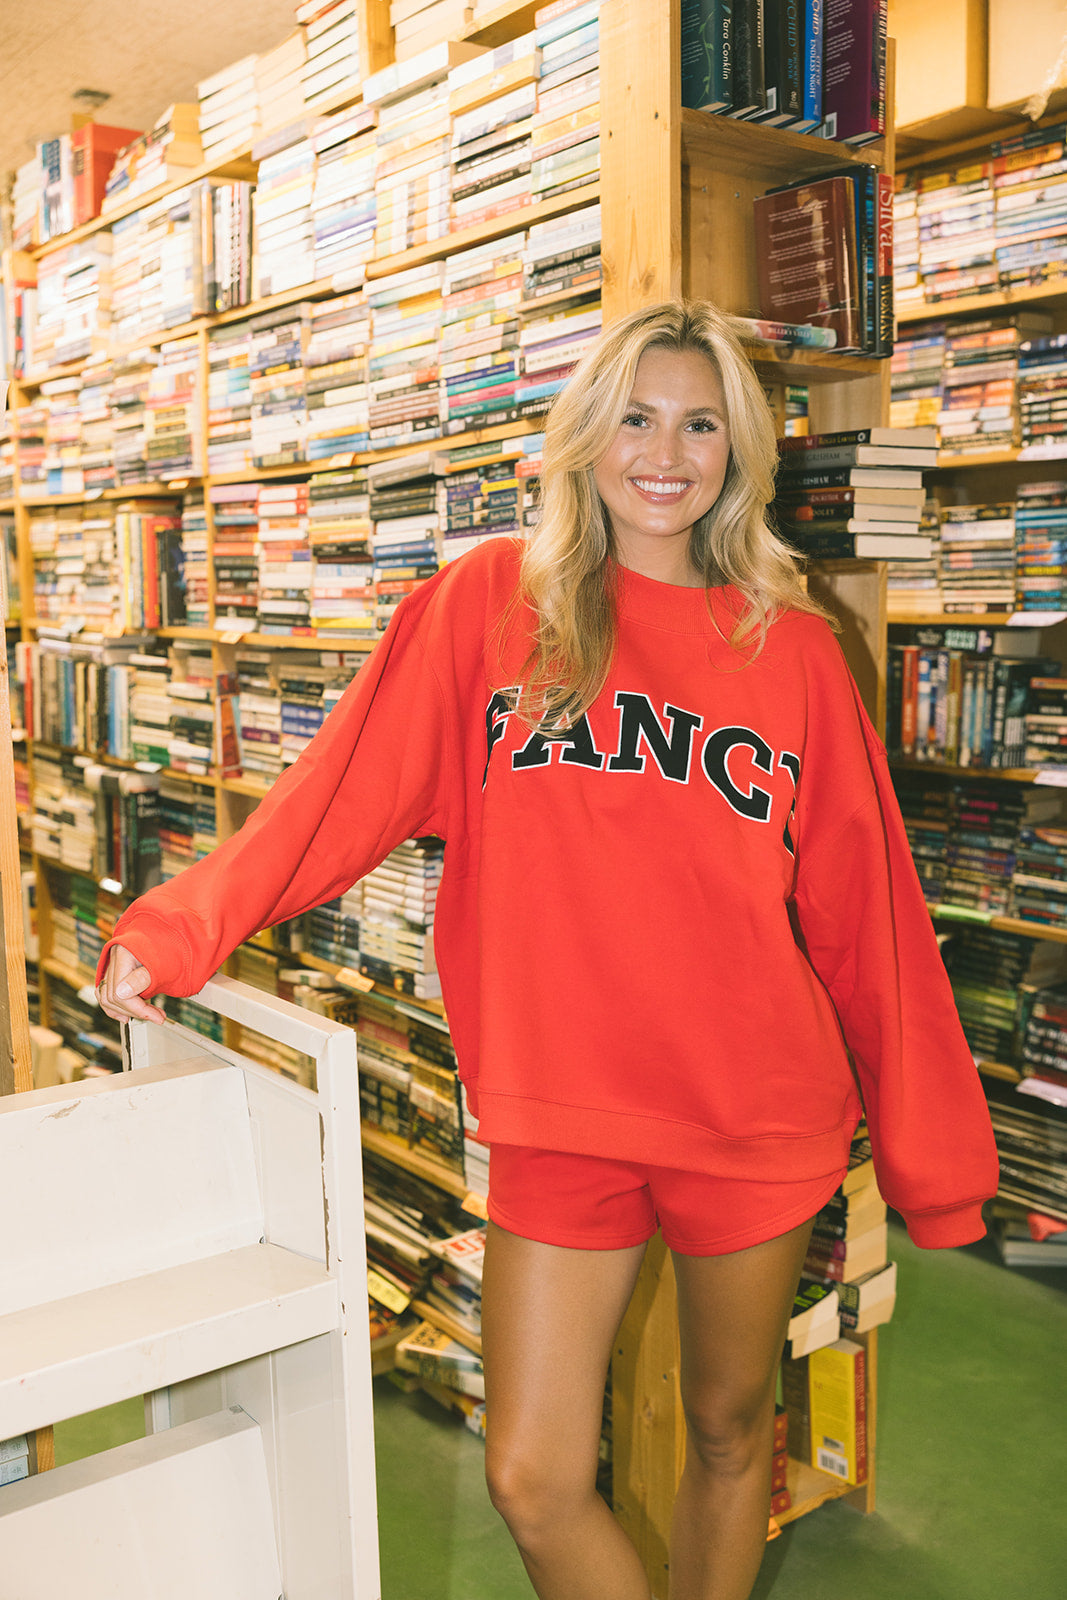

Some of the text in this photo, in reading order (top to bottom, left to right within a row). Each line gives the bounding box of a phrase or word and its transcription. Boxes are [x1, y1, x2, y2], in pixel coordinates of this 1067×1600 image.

[787, 5, 797, 47] CHILD
[812, 0, 820, 35] CHILD
[880, 0, 888, 40] WRIGHT
[722, 18, 732, 80] Tara Conklin
[880, 190, 894, 248] Silva
[807, 450, 840, 460] GRISHAM
[481, 685, 801, 860] FANC
